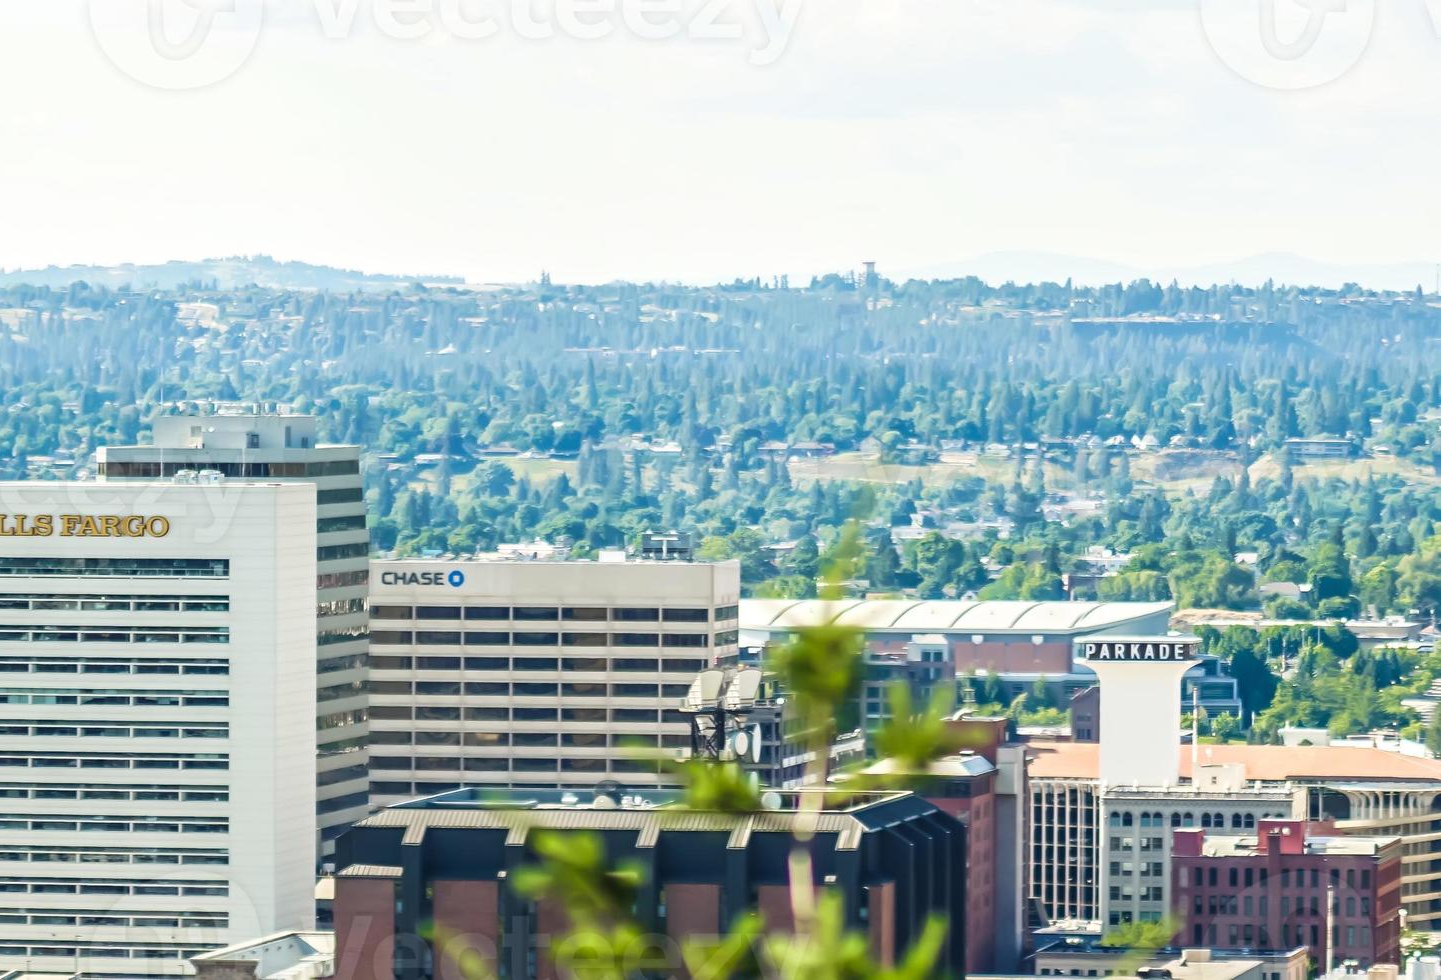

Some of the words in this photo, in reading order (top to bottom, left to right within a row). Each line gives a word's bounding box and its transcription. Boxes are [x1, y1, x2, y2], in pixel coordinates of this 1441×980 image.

[60, 515, 170, 537] FARGO
[382, 572, 445, 585] CHASE
[1085, 643, 1184, 659] PARKADE
